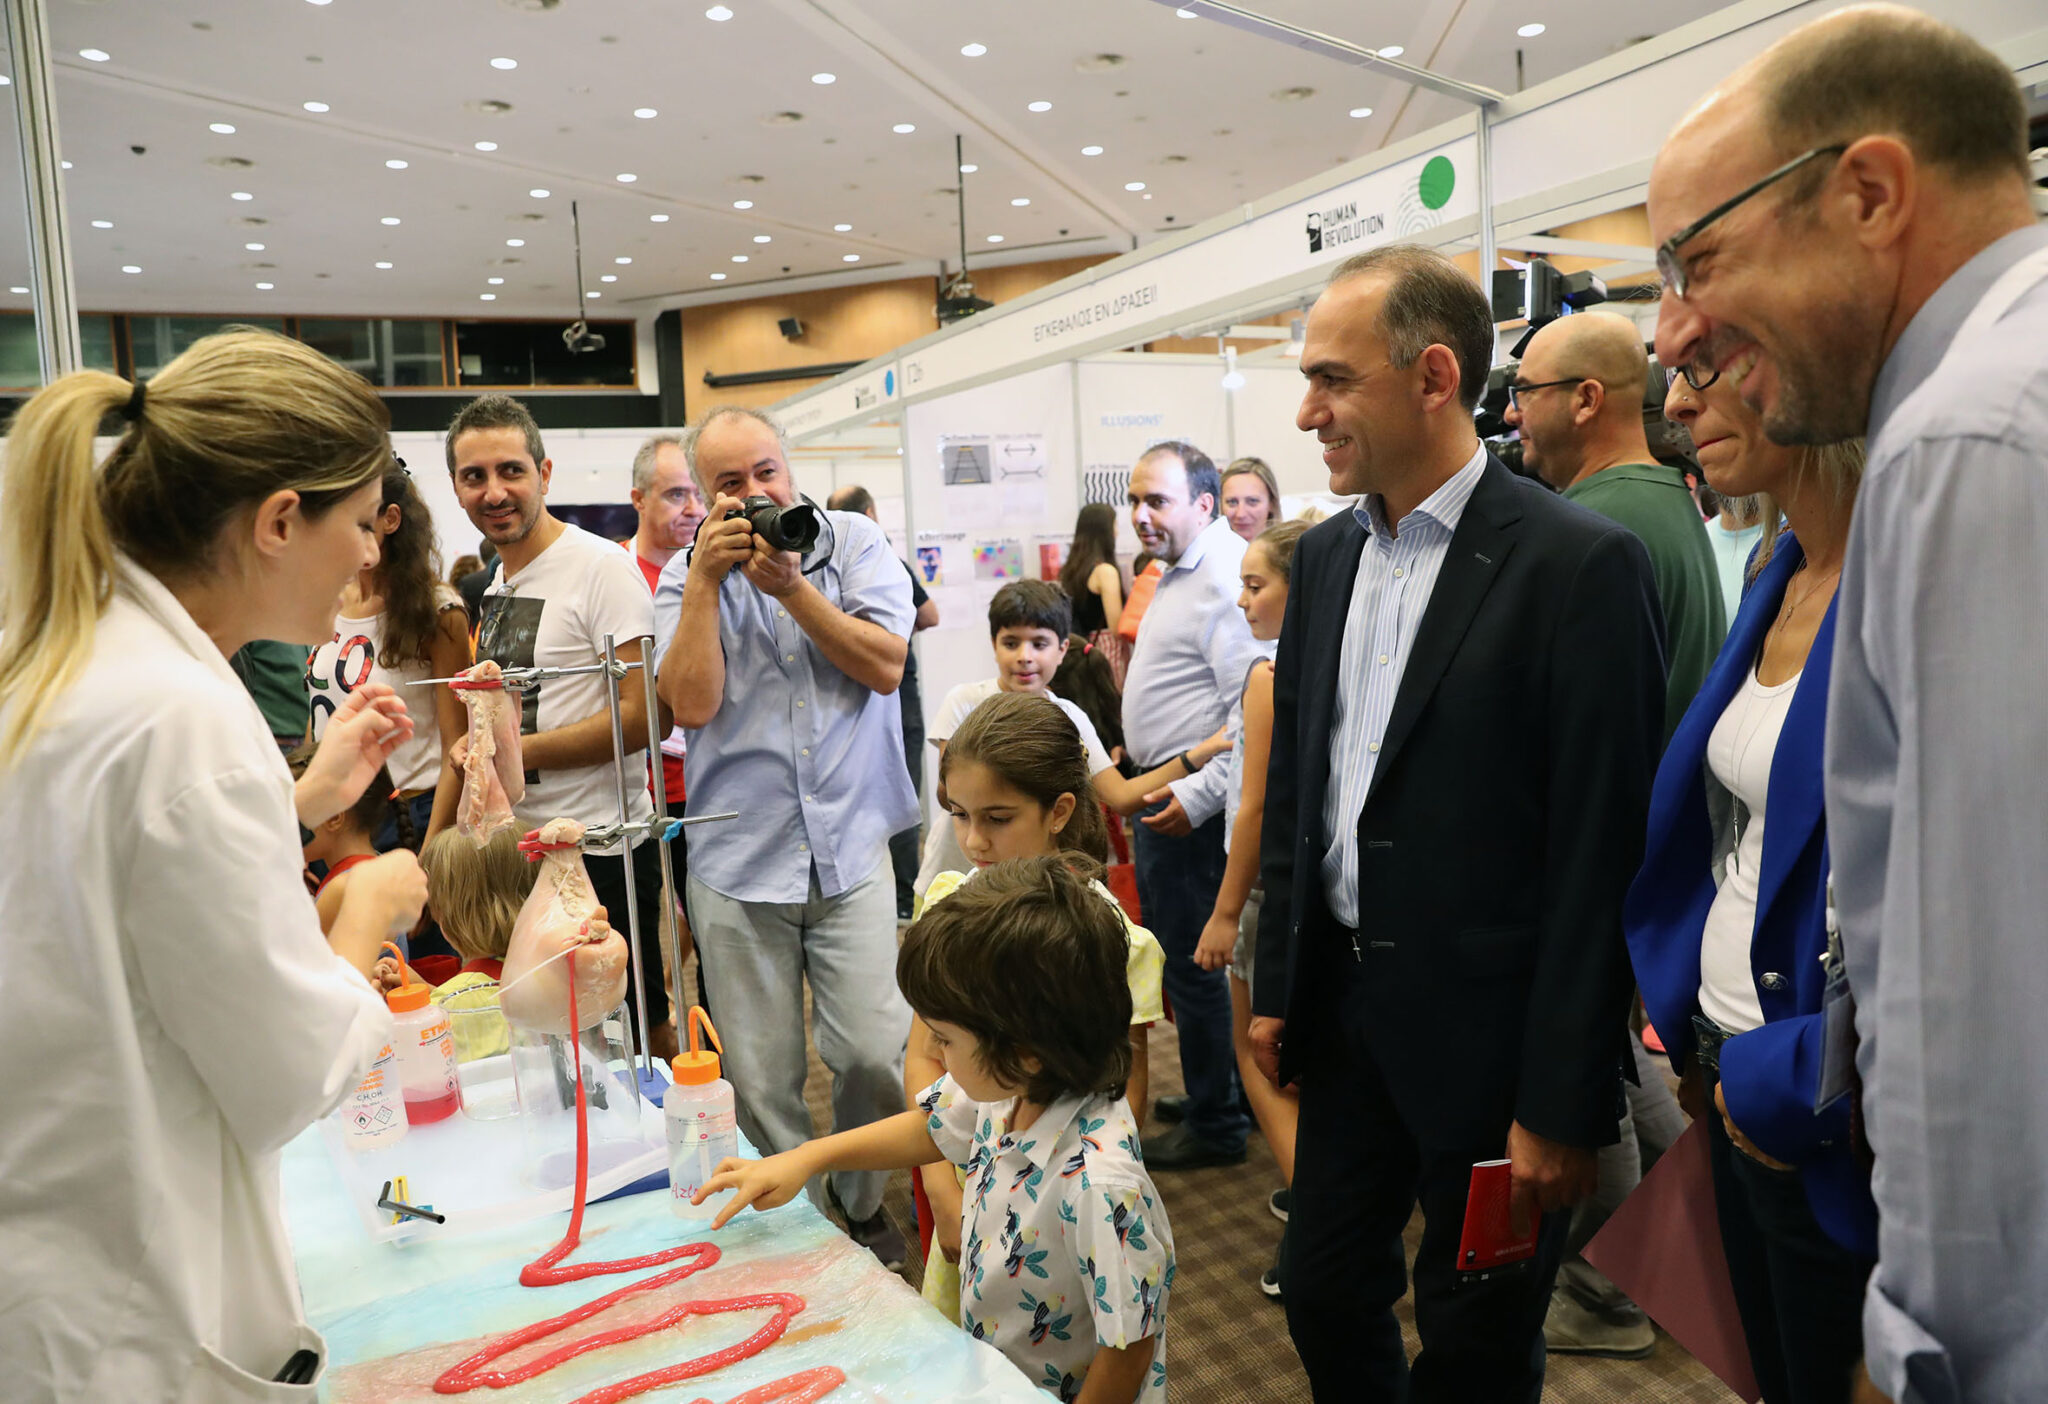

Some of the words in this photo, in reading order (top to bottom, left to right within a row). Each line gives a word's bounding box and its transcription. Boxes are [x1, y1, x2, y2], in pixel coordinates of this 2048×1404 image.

[1323, 202, 1357, 228] HUMAN
[1324, 213, 1384, 248] REVOLUTION
[1034, 308, 1092, 342] ΕΓΚΕΦΑΛΟΣ
[1095, 302, 1110, 322] ΕΝ
